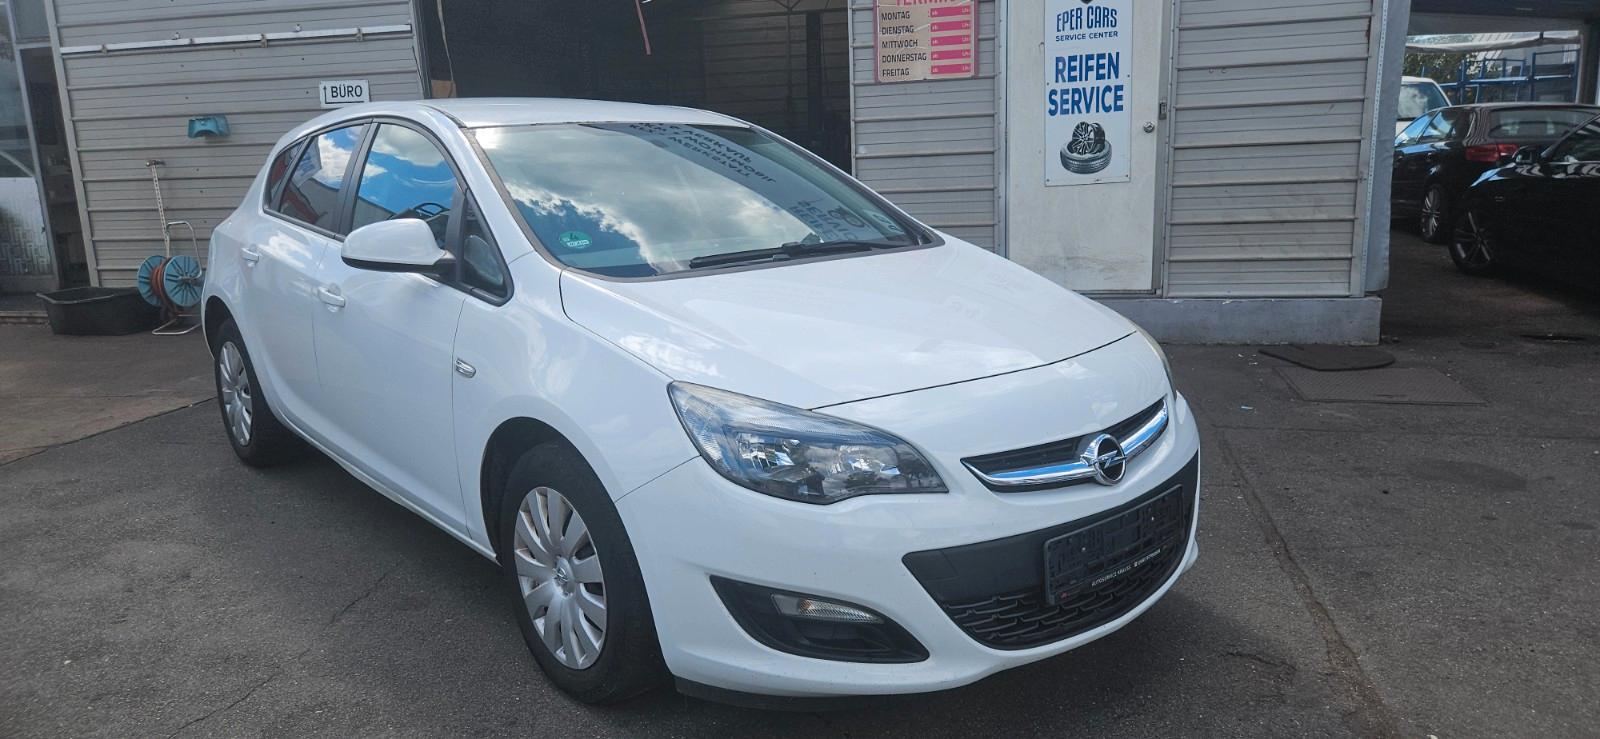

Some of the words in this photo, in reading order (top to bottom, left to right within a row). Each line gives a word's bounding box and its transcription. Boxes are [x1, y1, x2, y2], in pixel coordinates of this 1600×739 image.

[881, 11, 910, 21] MONTAG
[1056, 7, 1083, 33] EPER
[1086, 5, 1117, 29] CARS
[881, 25, 914, 35] DIENSTAG
[1055, 33, 1086, 42] SERVICE
[1088, 31, 1119, 39] CENTER
[881, 39, 918, 49] MITTWOCH
[881, 53, 927, 63] DONNERSTAG
[881, 68, 910, 77] FREITAG
[1055, 52, 1120, 83] REIFEN
[330, 84, 363, 98] BÜRO
[1048, 84, 1124, 117] SERVICE
